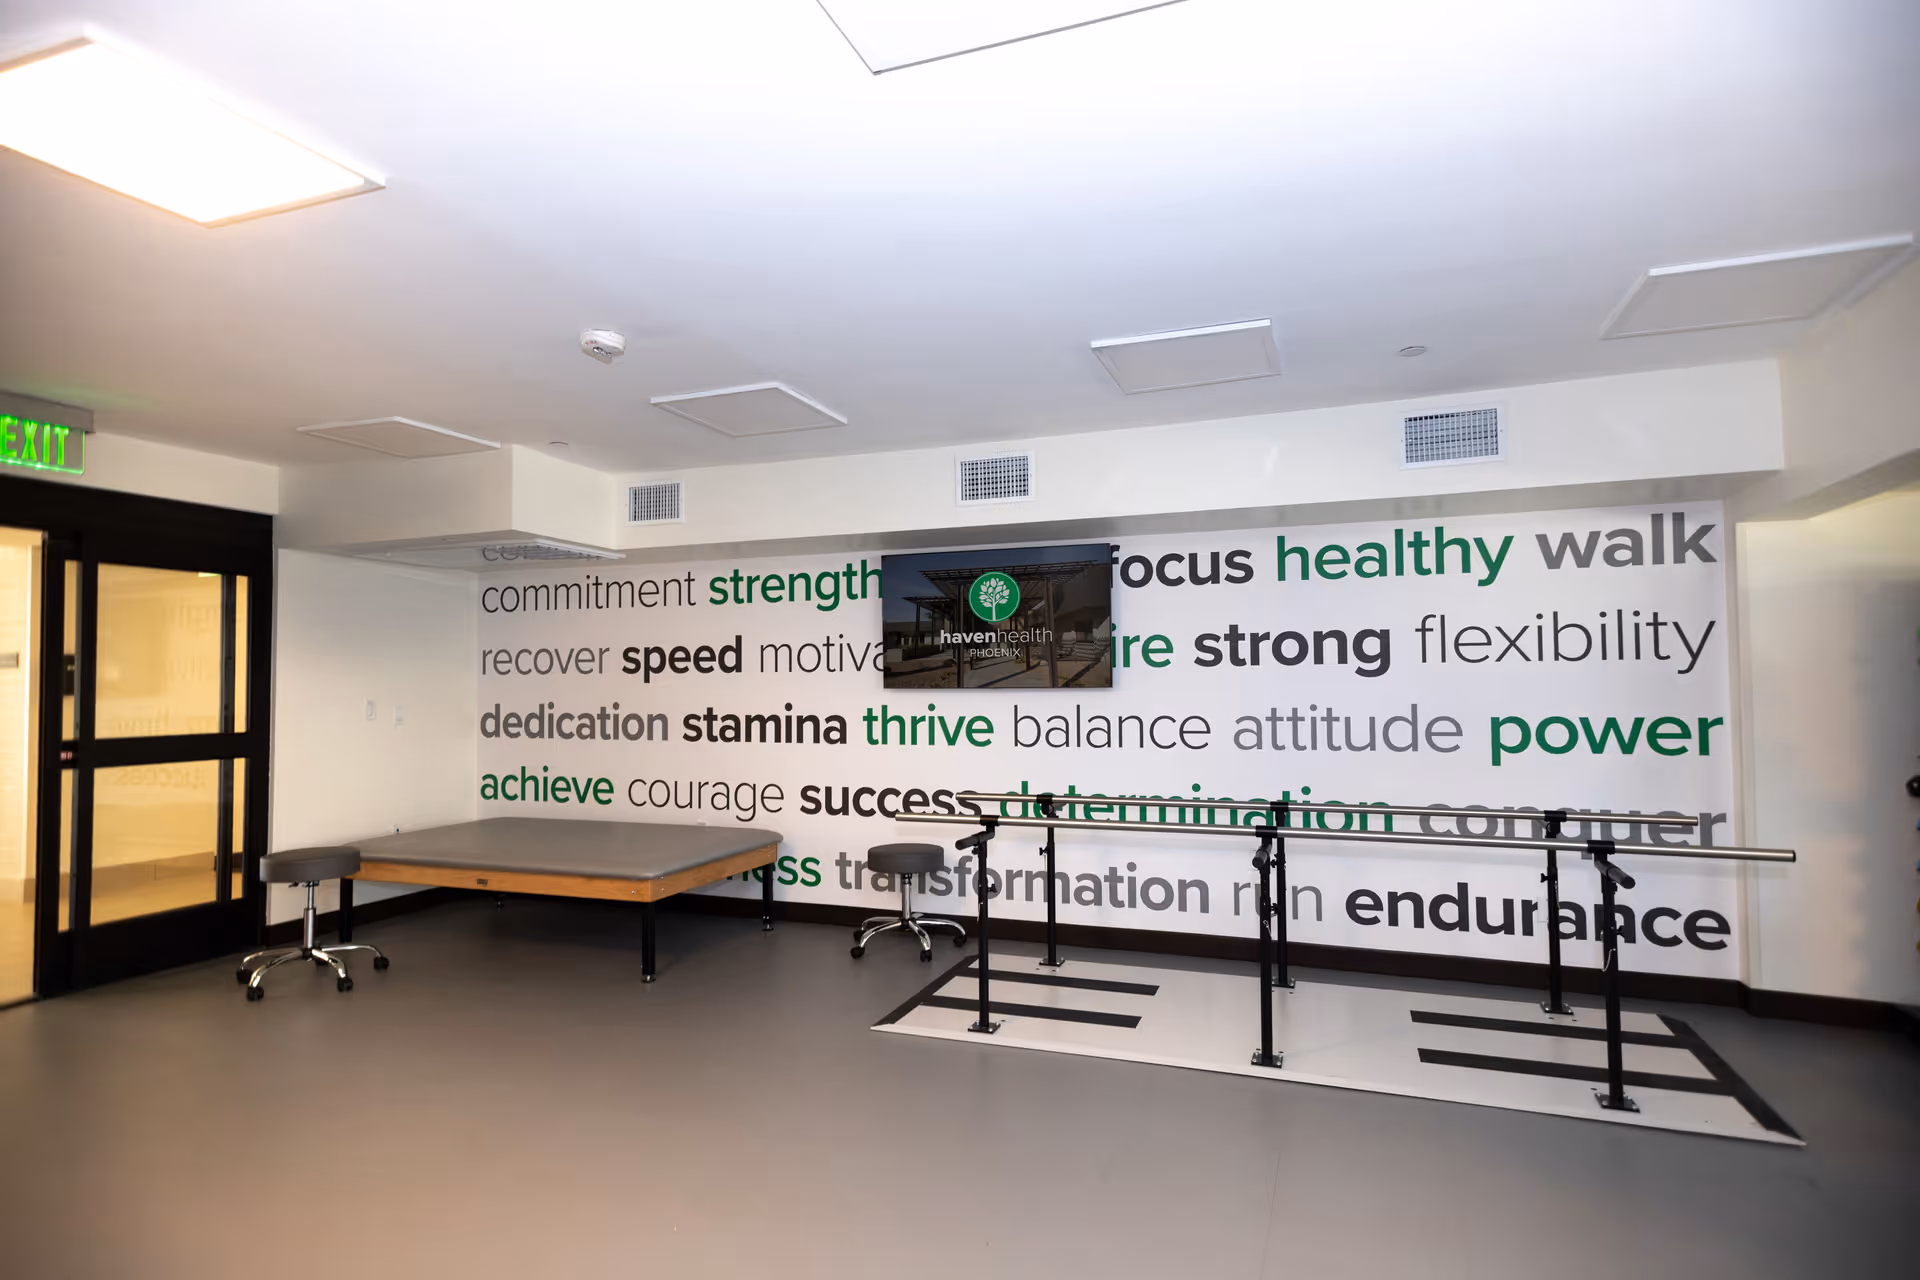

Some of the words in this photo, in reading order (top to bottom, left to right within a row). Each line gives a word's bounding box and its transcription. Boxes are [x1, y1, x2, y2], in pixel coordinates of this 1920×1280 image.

[0, 413, 69, 465] EXIT
[481, 571, 697, 613] commitment
[708, 559, 883, 612] strength
[1276, 526, 1514, 587] healthy
[1535, 511, 1718, 570] walk
[482, 646, 610, 676] recover
[622, 635, 743, 684] speed
[1194, 624, 1391, 678] strong
[1415, 609, 1717, 675] flexibility
[940, 627, 1053, 645] havenhealth
[970, 648, 1021, 658] PHOENIX
[480, 702, 669, 741] dedication
[683, 702, 848, 745] stamina
[862, 703, 995, 748] thrive
[1013, 704, 1212, 750] balance
[1233, 703, 1464, 753] attitude
[1490, 715, 1725, 767] power
[480, 766, 615, 805] achieve
[628, 778, 785, 823] courage
[800, 782, 983, 820] success
[1418, 802, 1727, 860] conquer
[1345, 882, 1731, 951] endurance
